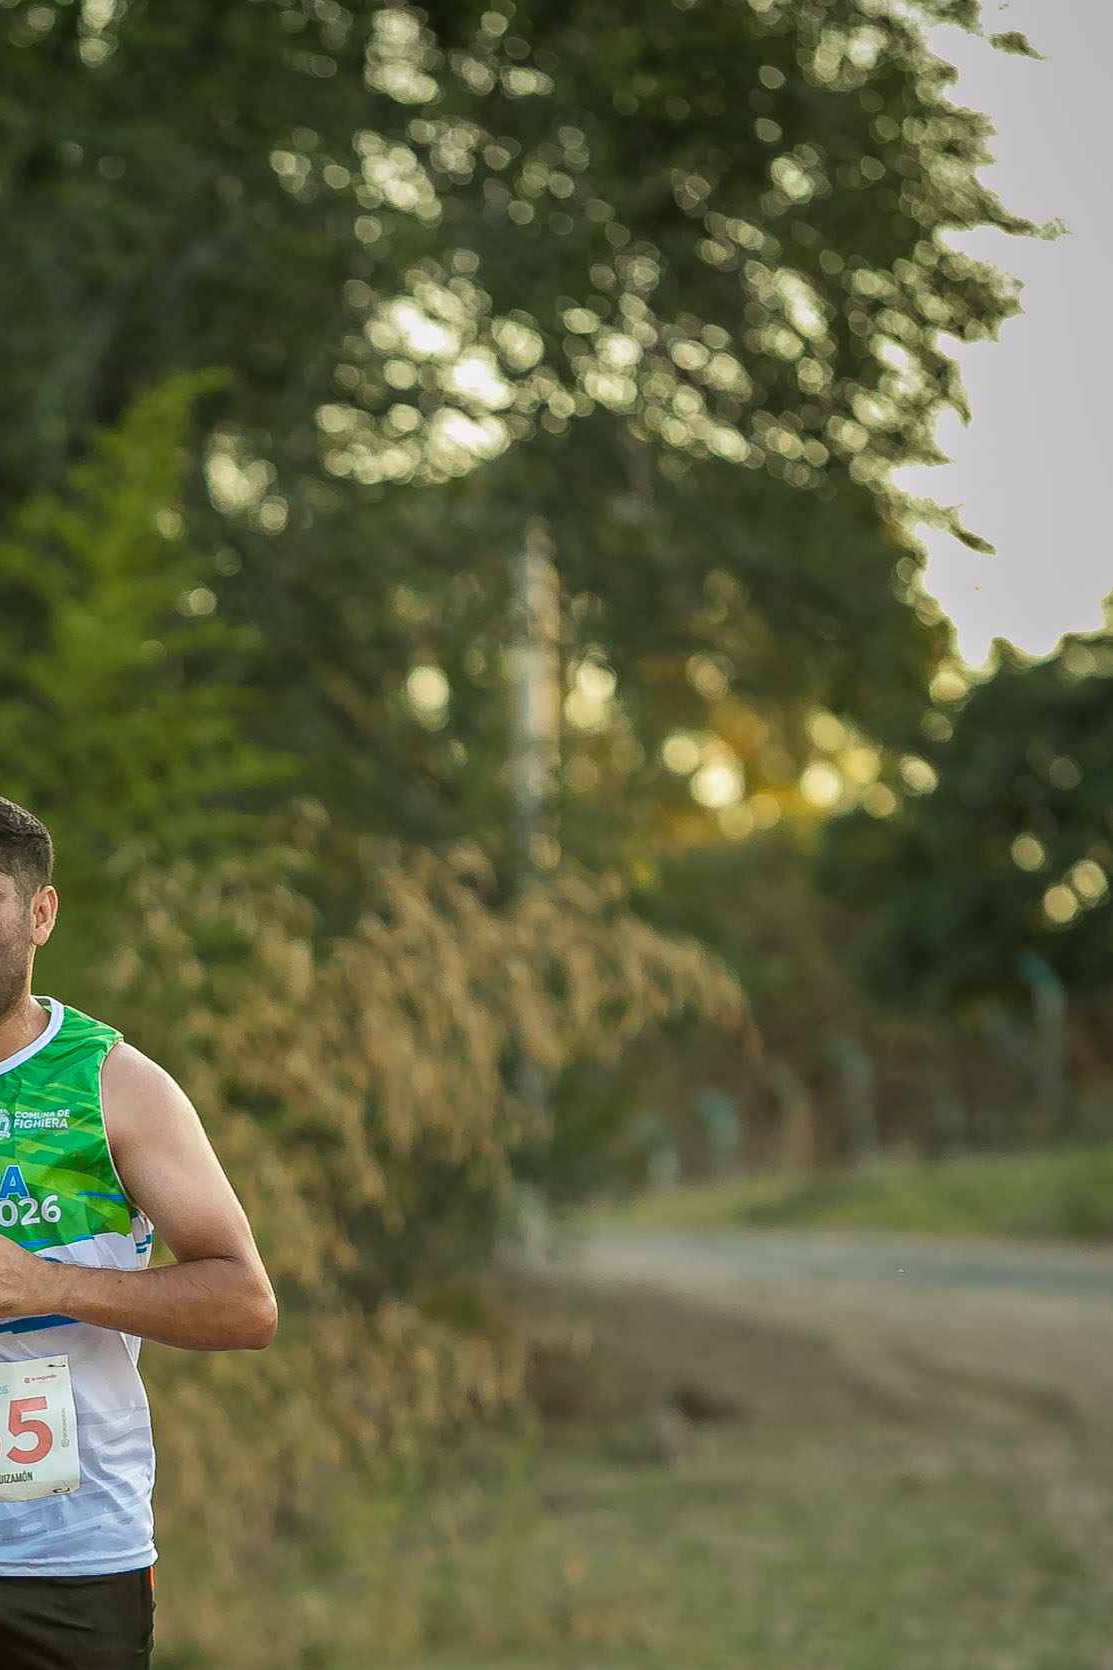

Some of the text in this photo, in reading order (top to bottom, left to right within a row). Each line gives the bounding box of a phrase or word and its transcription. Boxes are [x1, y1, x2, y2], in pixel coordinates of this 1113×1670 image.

[14, 1110, 55, 1119] COMUNA
[57, 1108, 71, 1118] DE
[13, 1118, 68, 1129] FIGHIERA
